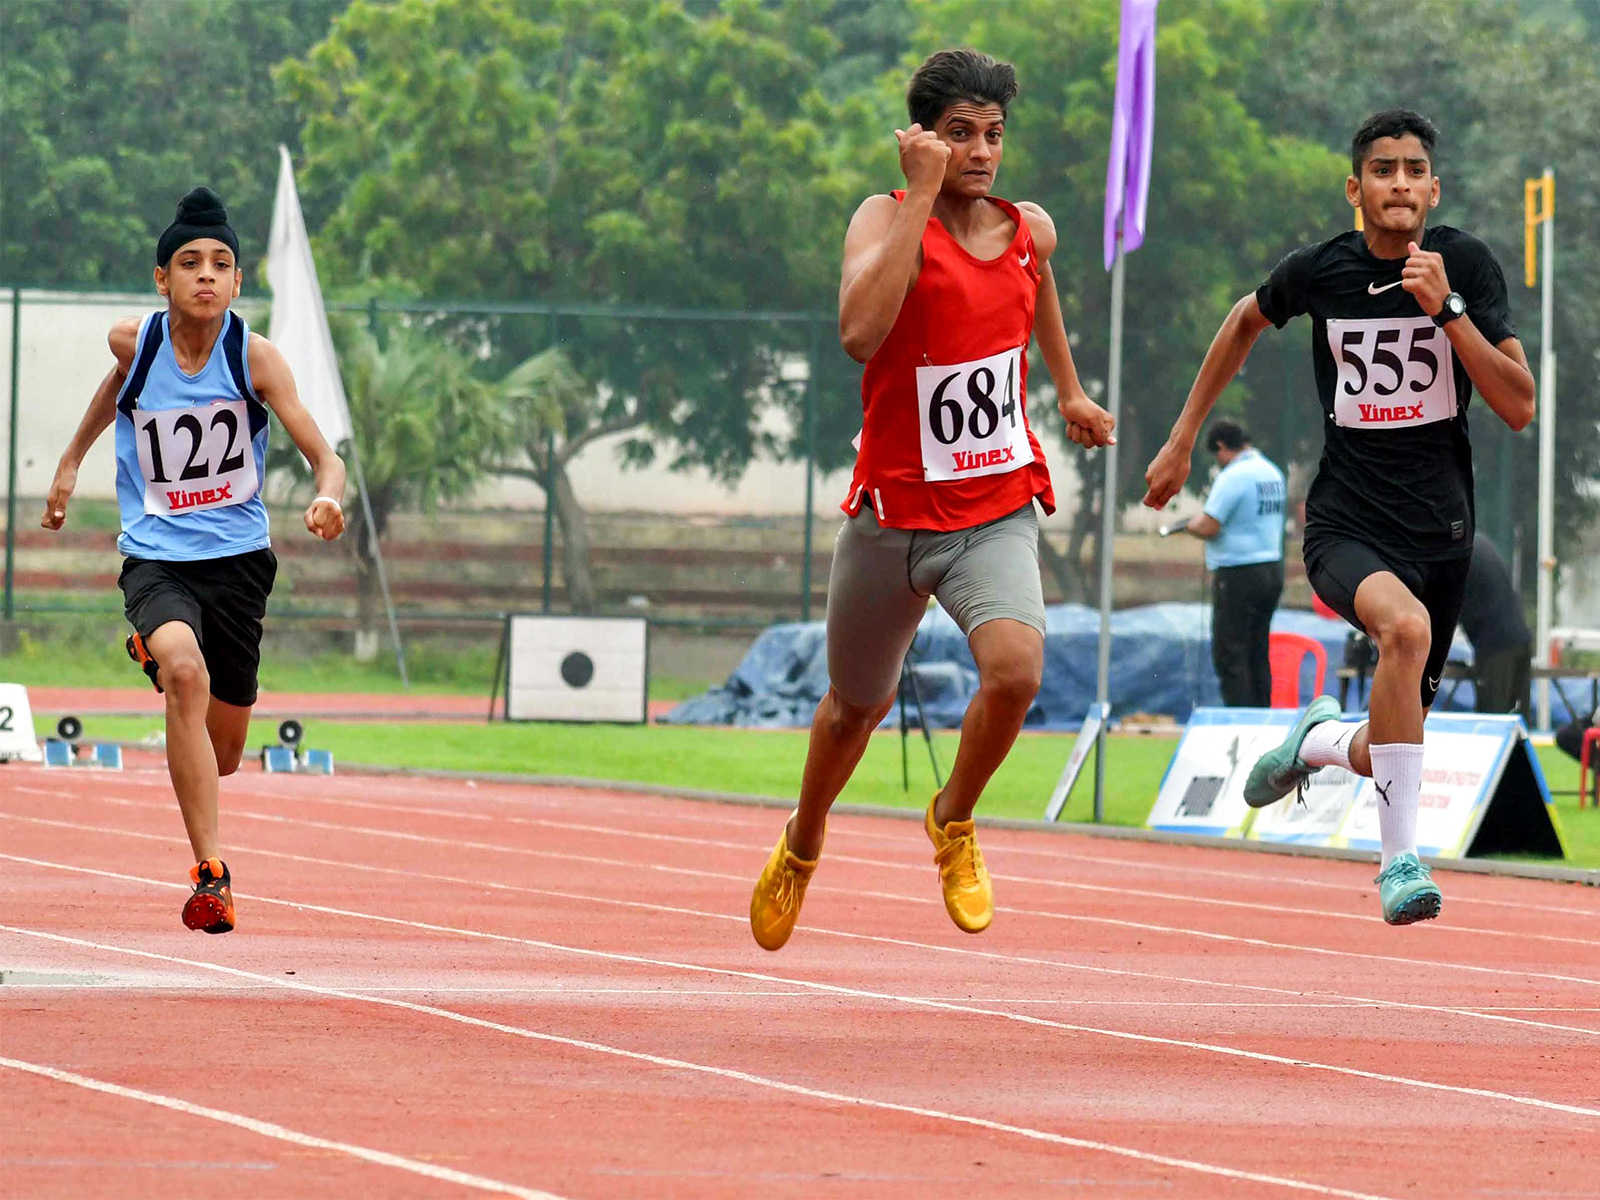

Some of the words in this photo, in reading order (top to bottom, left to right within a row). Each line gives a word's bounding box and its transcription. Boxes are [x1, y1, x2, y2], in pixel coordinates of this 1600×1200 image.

[1341, 326, 1439, 395] 555
[929, 357, 1016, 444] 684
[1358, 402, 1424, 422] Vinex
[142, 409, 244, 483] 122
[952, 446, 1015, 472] Vinex
[166, 482, 232, 510] Vinex
